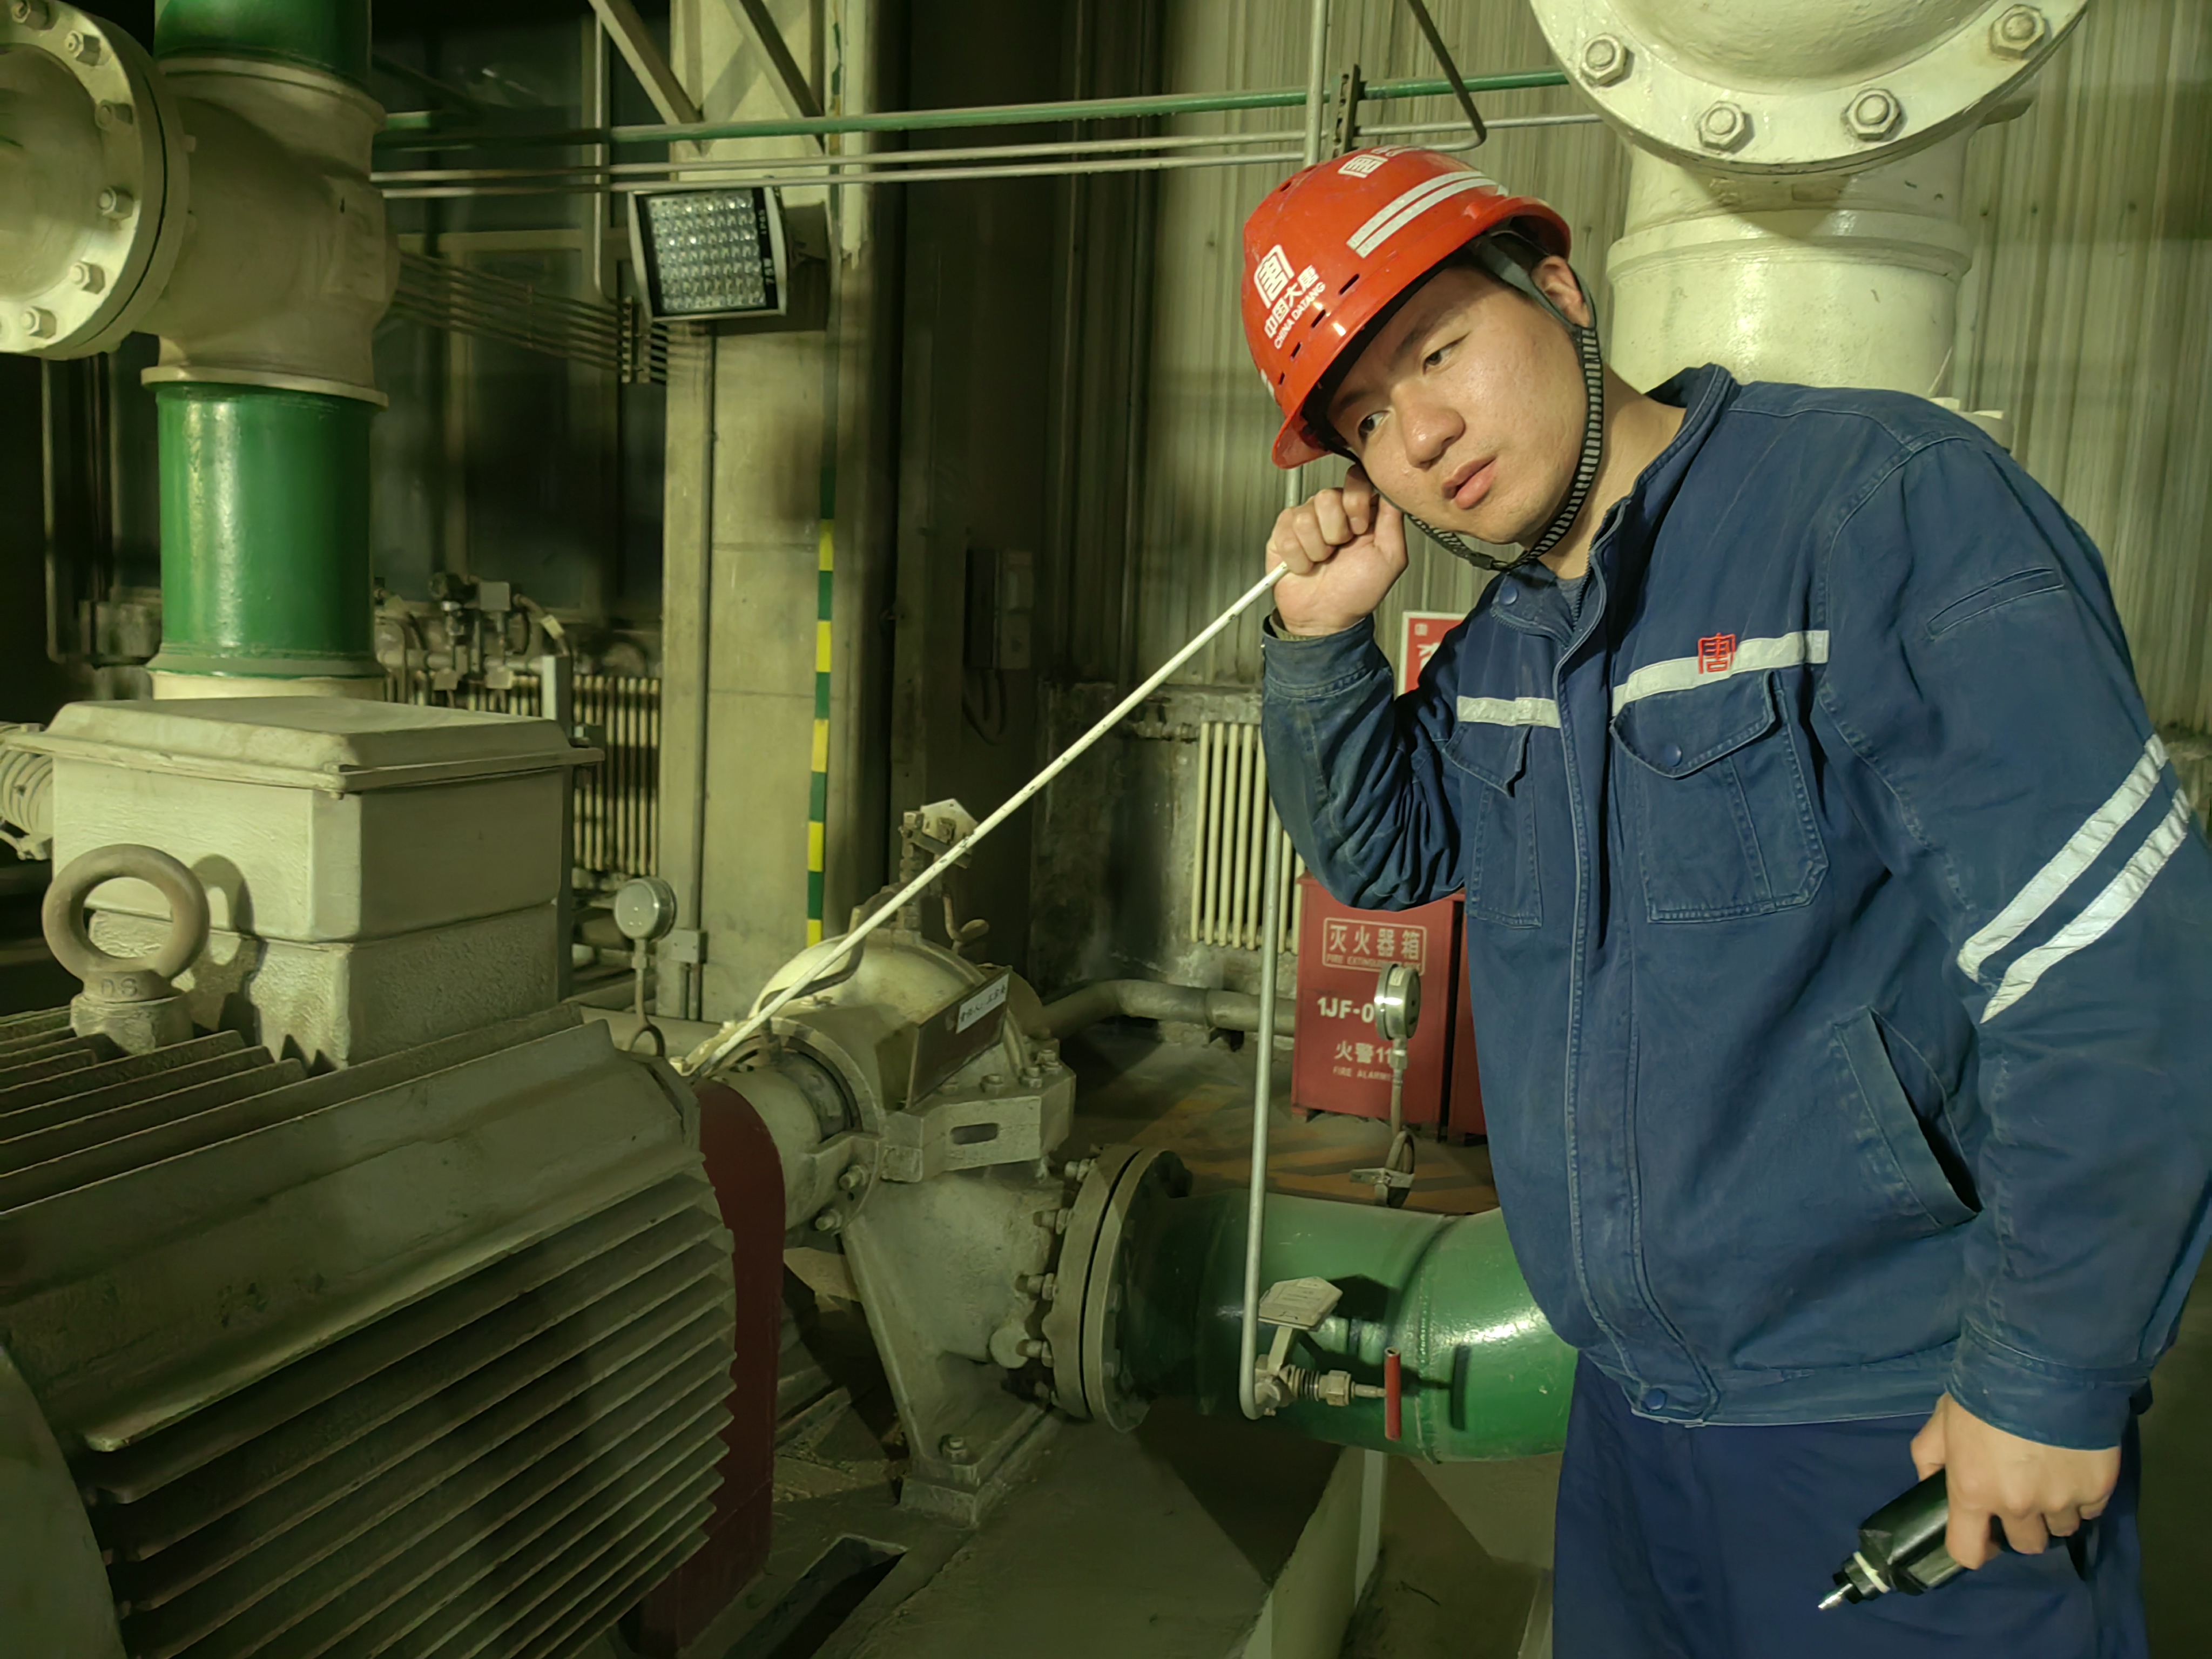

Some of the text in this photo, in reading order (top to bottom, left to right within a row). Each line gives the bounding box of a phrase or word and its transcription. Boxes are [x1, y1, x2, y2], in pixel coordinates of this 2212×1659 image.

[1264, 265, 1319, 339] 中国大唐
[1274, 282, 1326, 349] CHINA DATANG
[1329, 924, 1420, 960] 灭火器箱
[1317, 997, 1375, 1023] 1JF-0
[1334, 1040, 1392, 1064] 火警11
